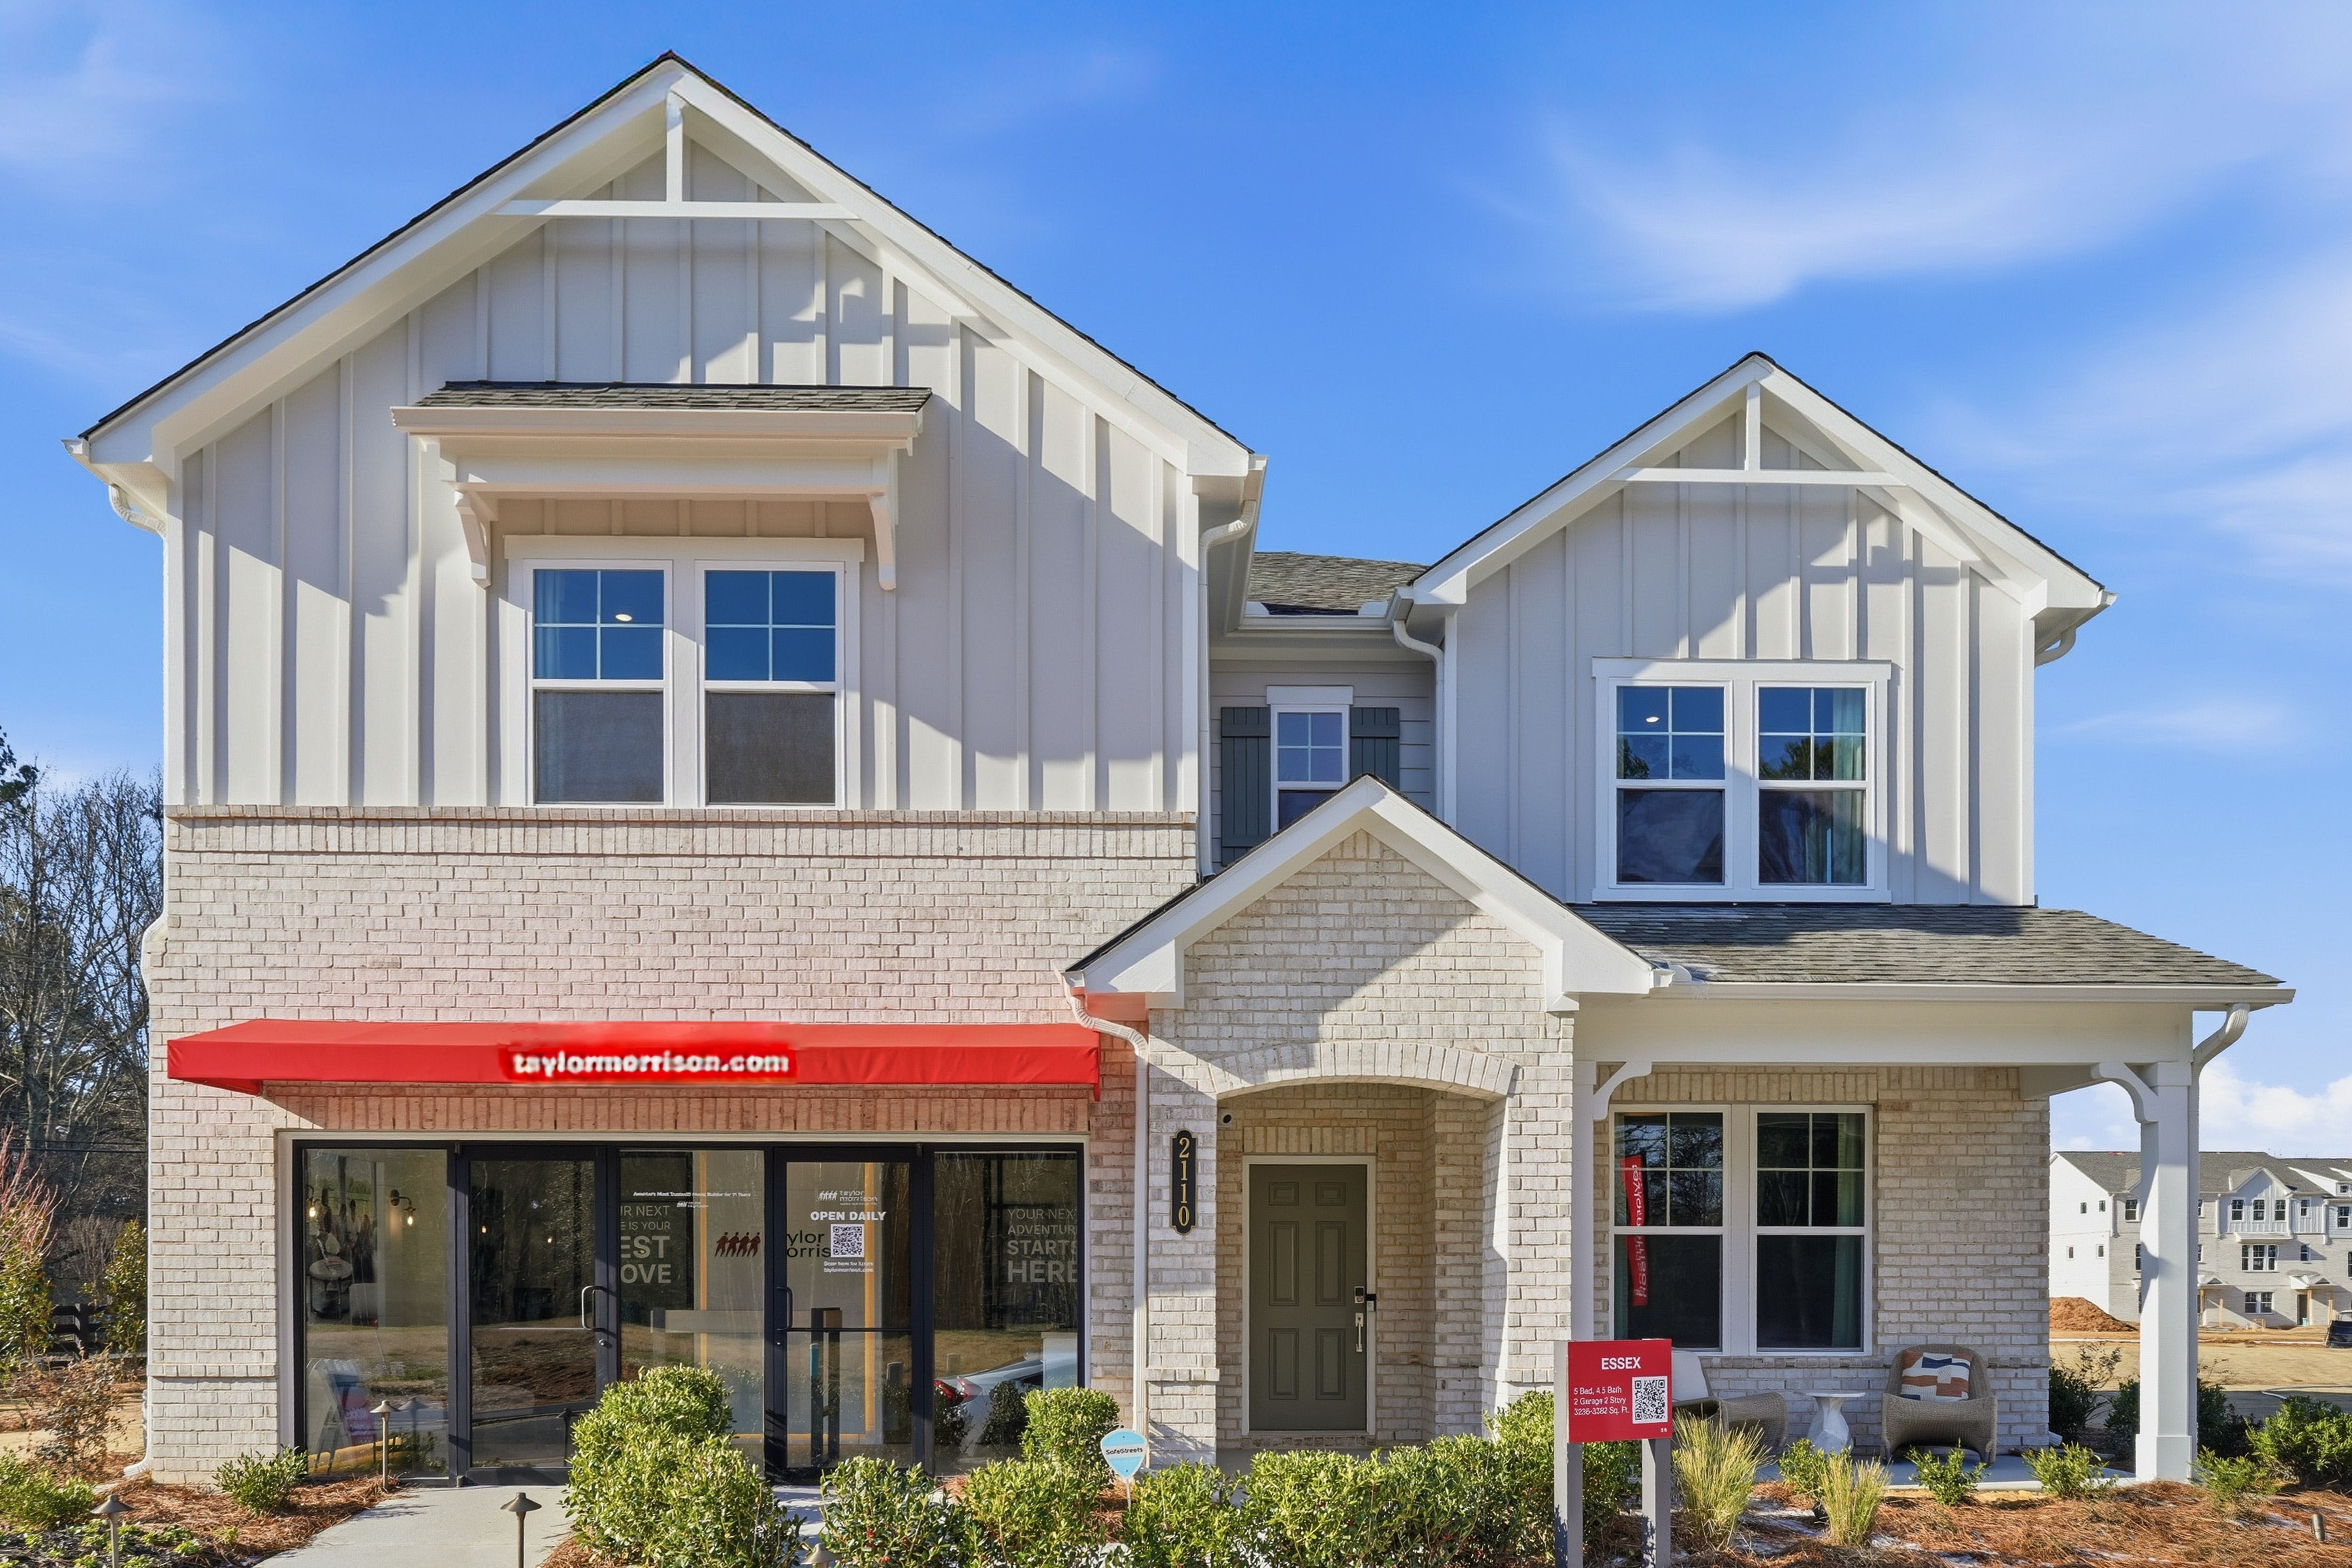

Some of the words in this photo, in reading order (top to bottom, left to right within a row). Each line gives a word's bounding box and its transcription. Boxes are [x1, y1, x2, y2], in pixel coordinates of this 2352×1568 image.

[513, 1050, 790, 1077] taylormorrison.com
[1178, 1137, 1190, 1226] 2110
[636, 1206, 670, 1216] NEXT
[810, 1211, 845, 1220] OPEN
[849, 1211, 887, 1220] DAILY
[1008, 1209, 1044, 1219] YOUR
[629, 1222, 638, 1230] IS
[641, 1221, 671, 1230] YOUR
[1008, 1260, 1078, 1283] HERE
[1601, 1357, 1641, 1370] ESSEX
[1580, 1387, 1594, 1395] Bed,
[1610, 1396, 1626, 1405] Story
[1609, 1406, 1620, 1415] Sq.
